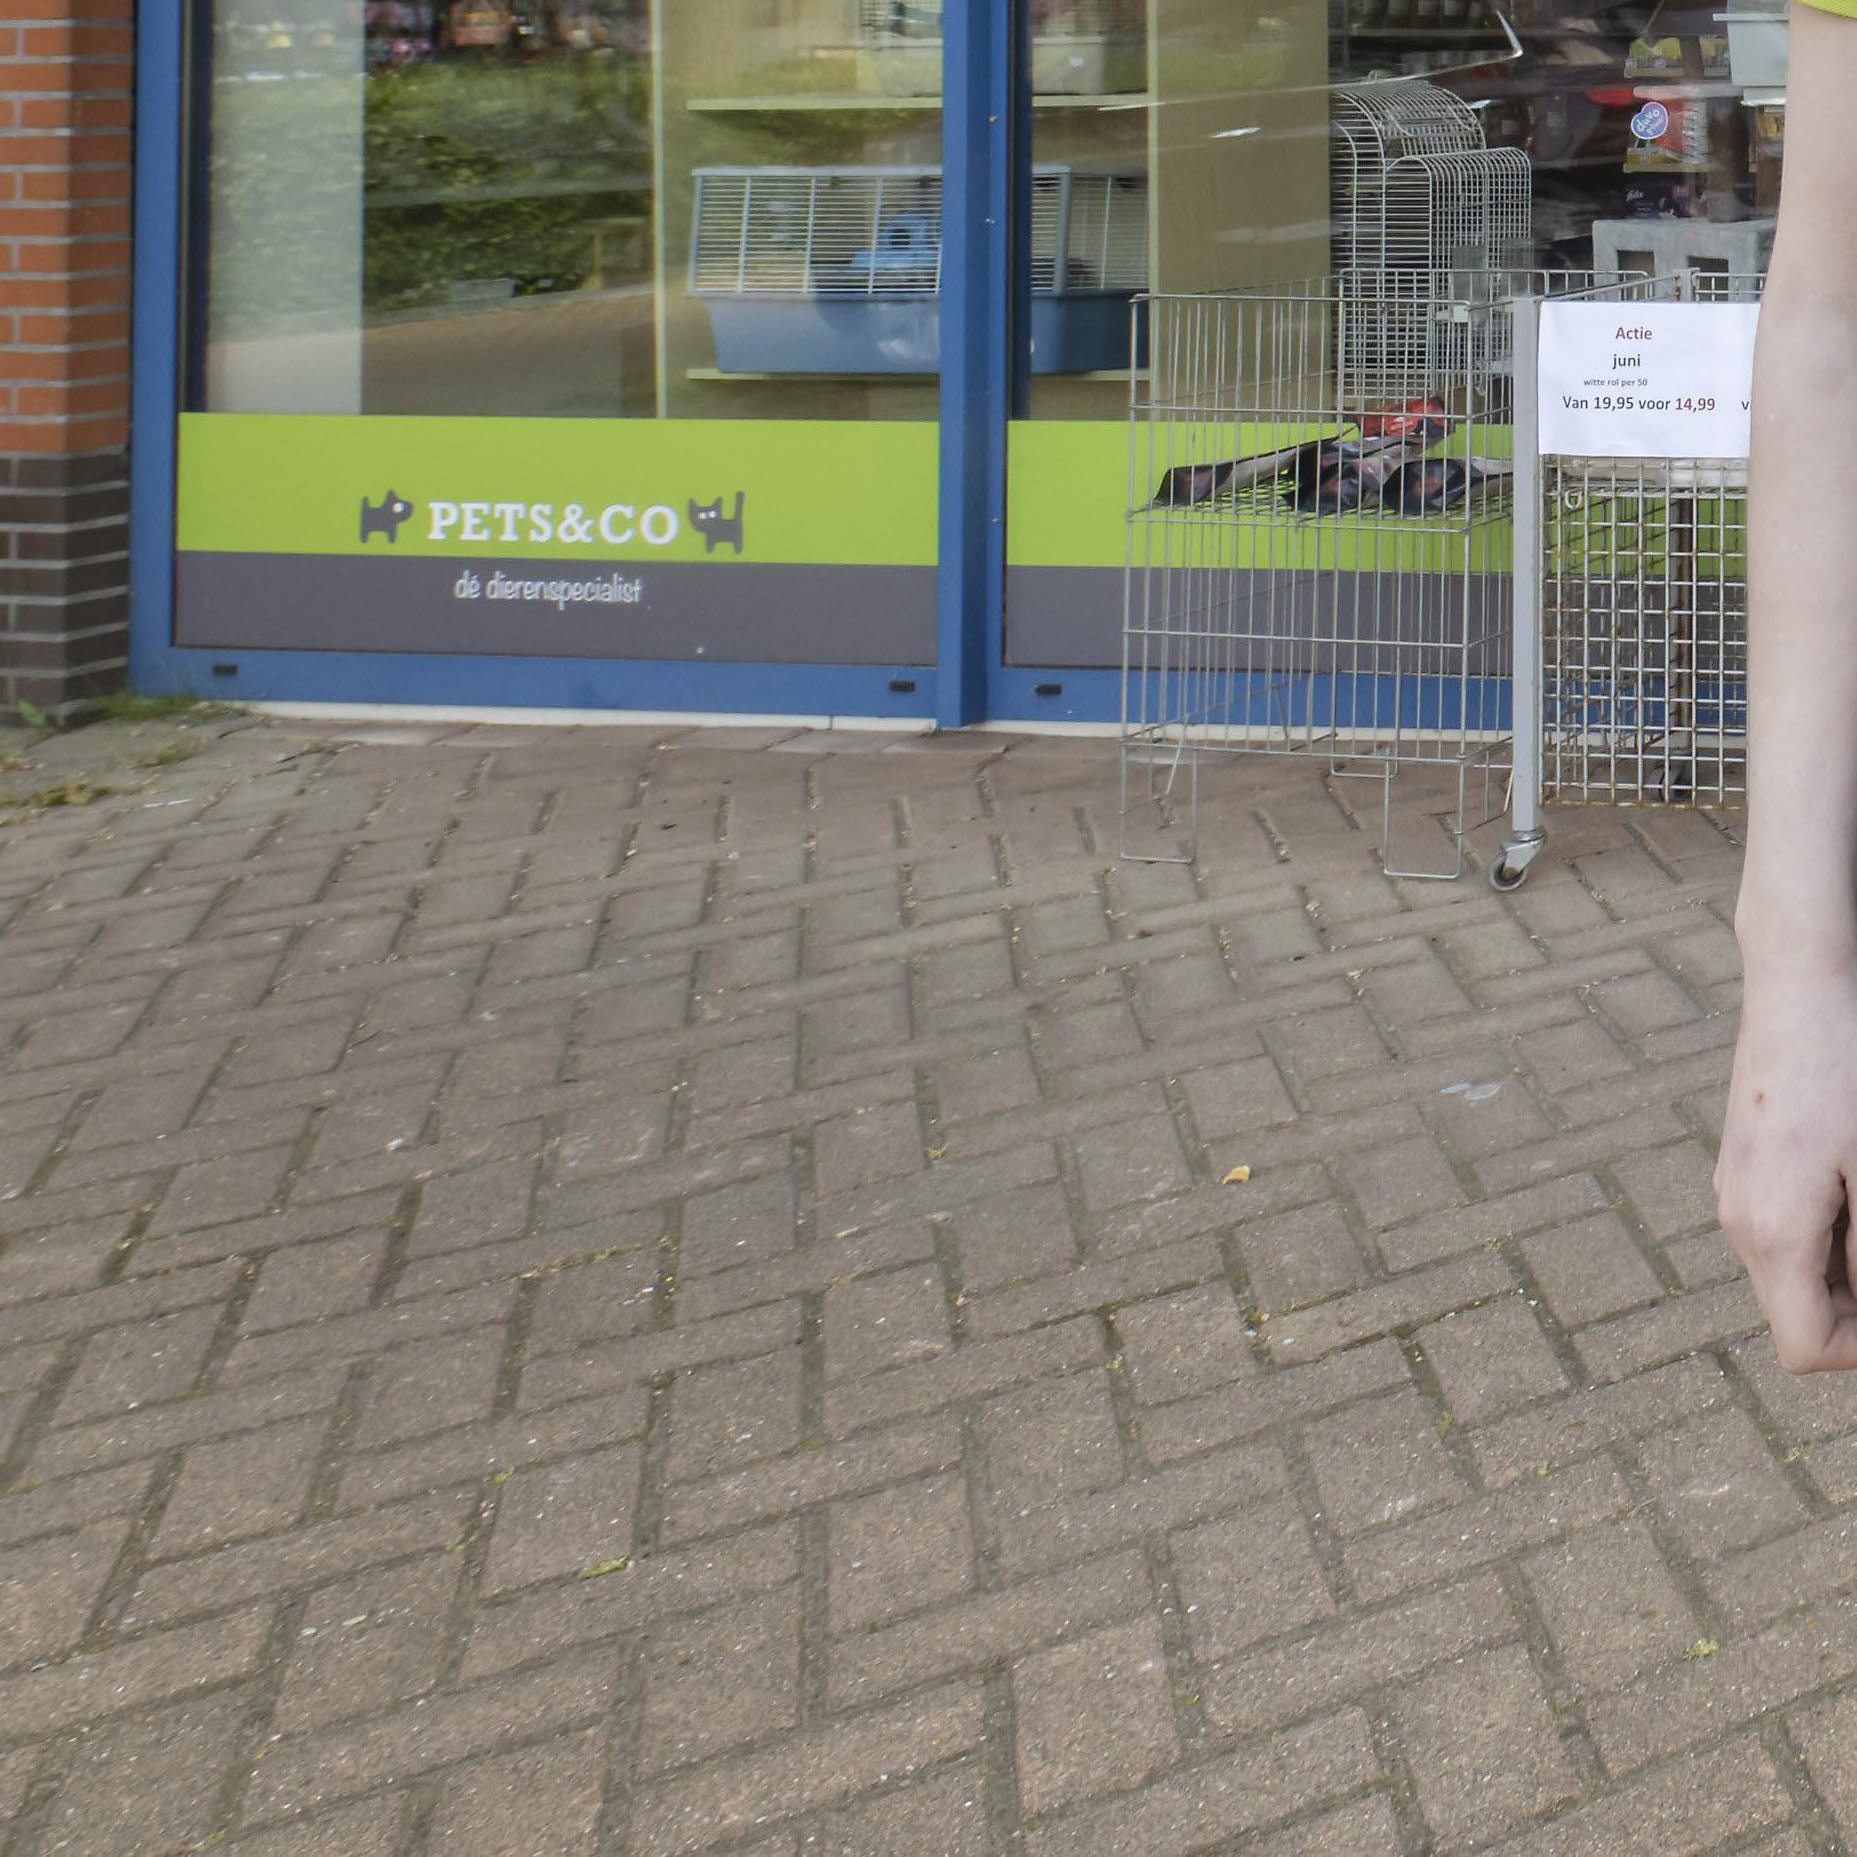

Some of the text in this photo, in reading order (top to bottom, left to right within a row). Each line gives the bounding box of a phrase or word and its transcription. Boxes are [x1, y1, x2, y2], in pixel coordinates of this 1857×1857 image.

[1636, 109, 1660, 132] duvo
[1615, 326, 1653, 340] Actie
[1612, 353, 1641, 369] juni
[1583, 378, 1648, 388] witte rol per 50
[1562, 396, 1588, 409] Van
[1593, 396, 1634, 411] 19,95
[1638, 399, 1671, 410] voor
[1675, 397, 1716, 413] 14,99
[427, 501, 679, 545] PETS&CO
[454, 569, 643, 611] dé dierenspecialist
